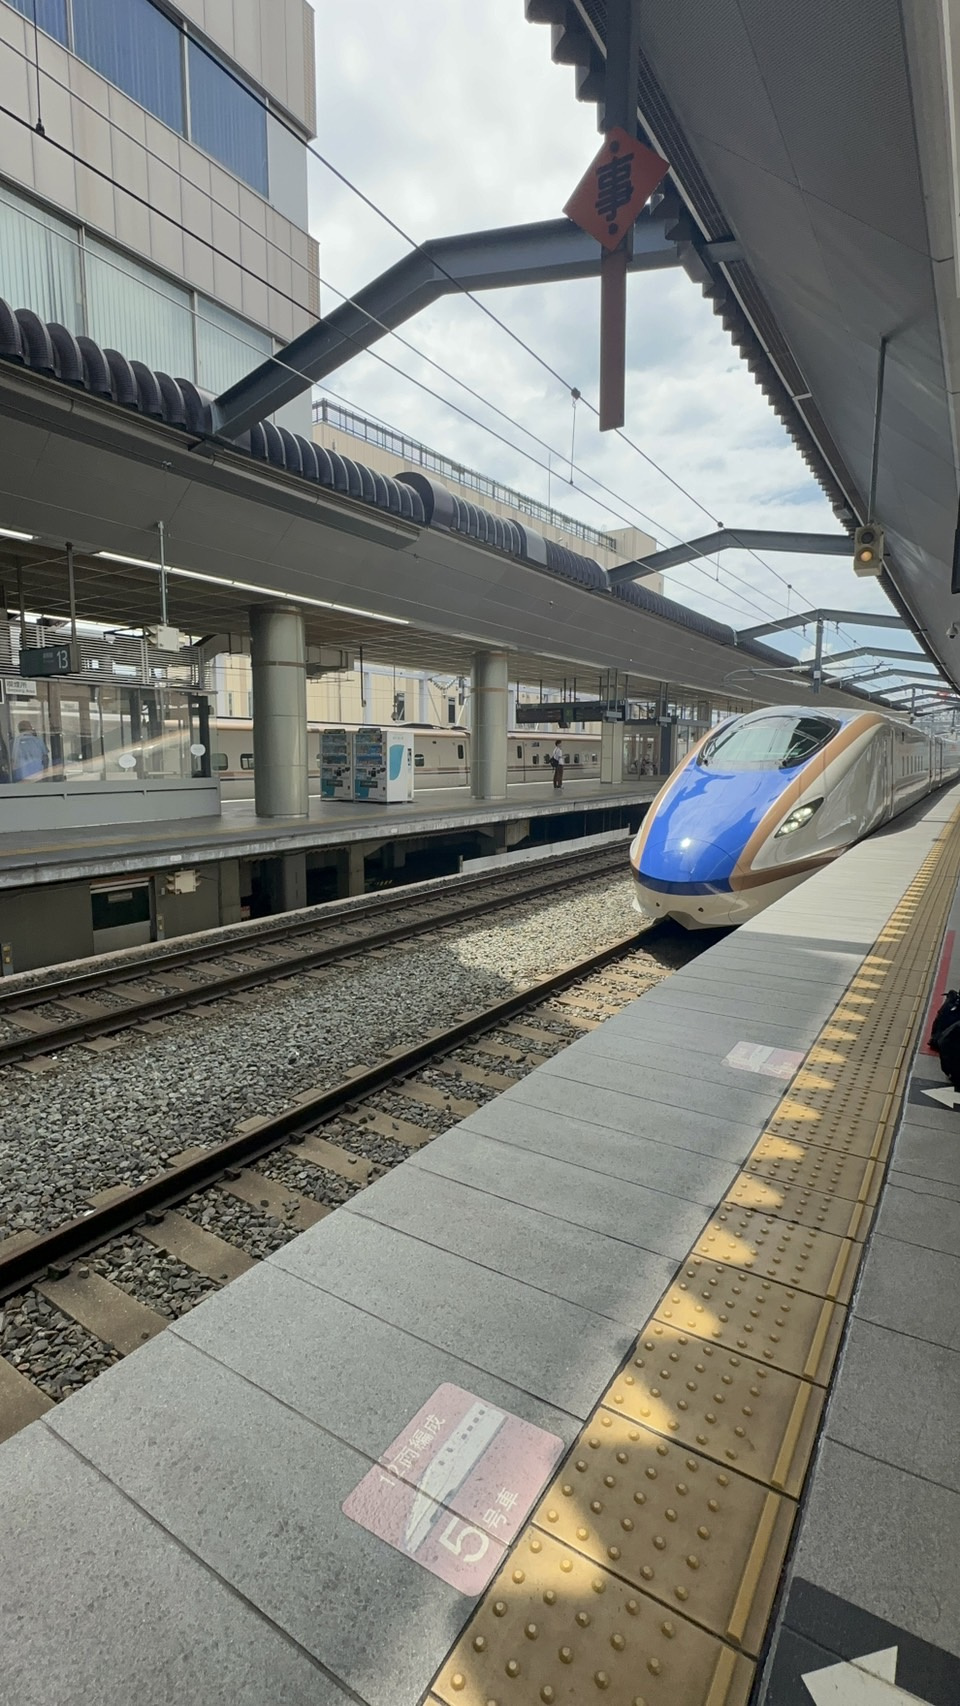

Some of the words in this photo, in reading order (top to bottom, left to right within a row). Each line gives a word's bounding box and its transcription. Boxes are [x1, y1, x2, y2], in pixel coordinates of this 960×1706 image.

[56, 650, 69, 669] 13
[379, 1414, 446, 1487] 12両編成
